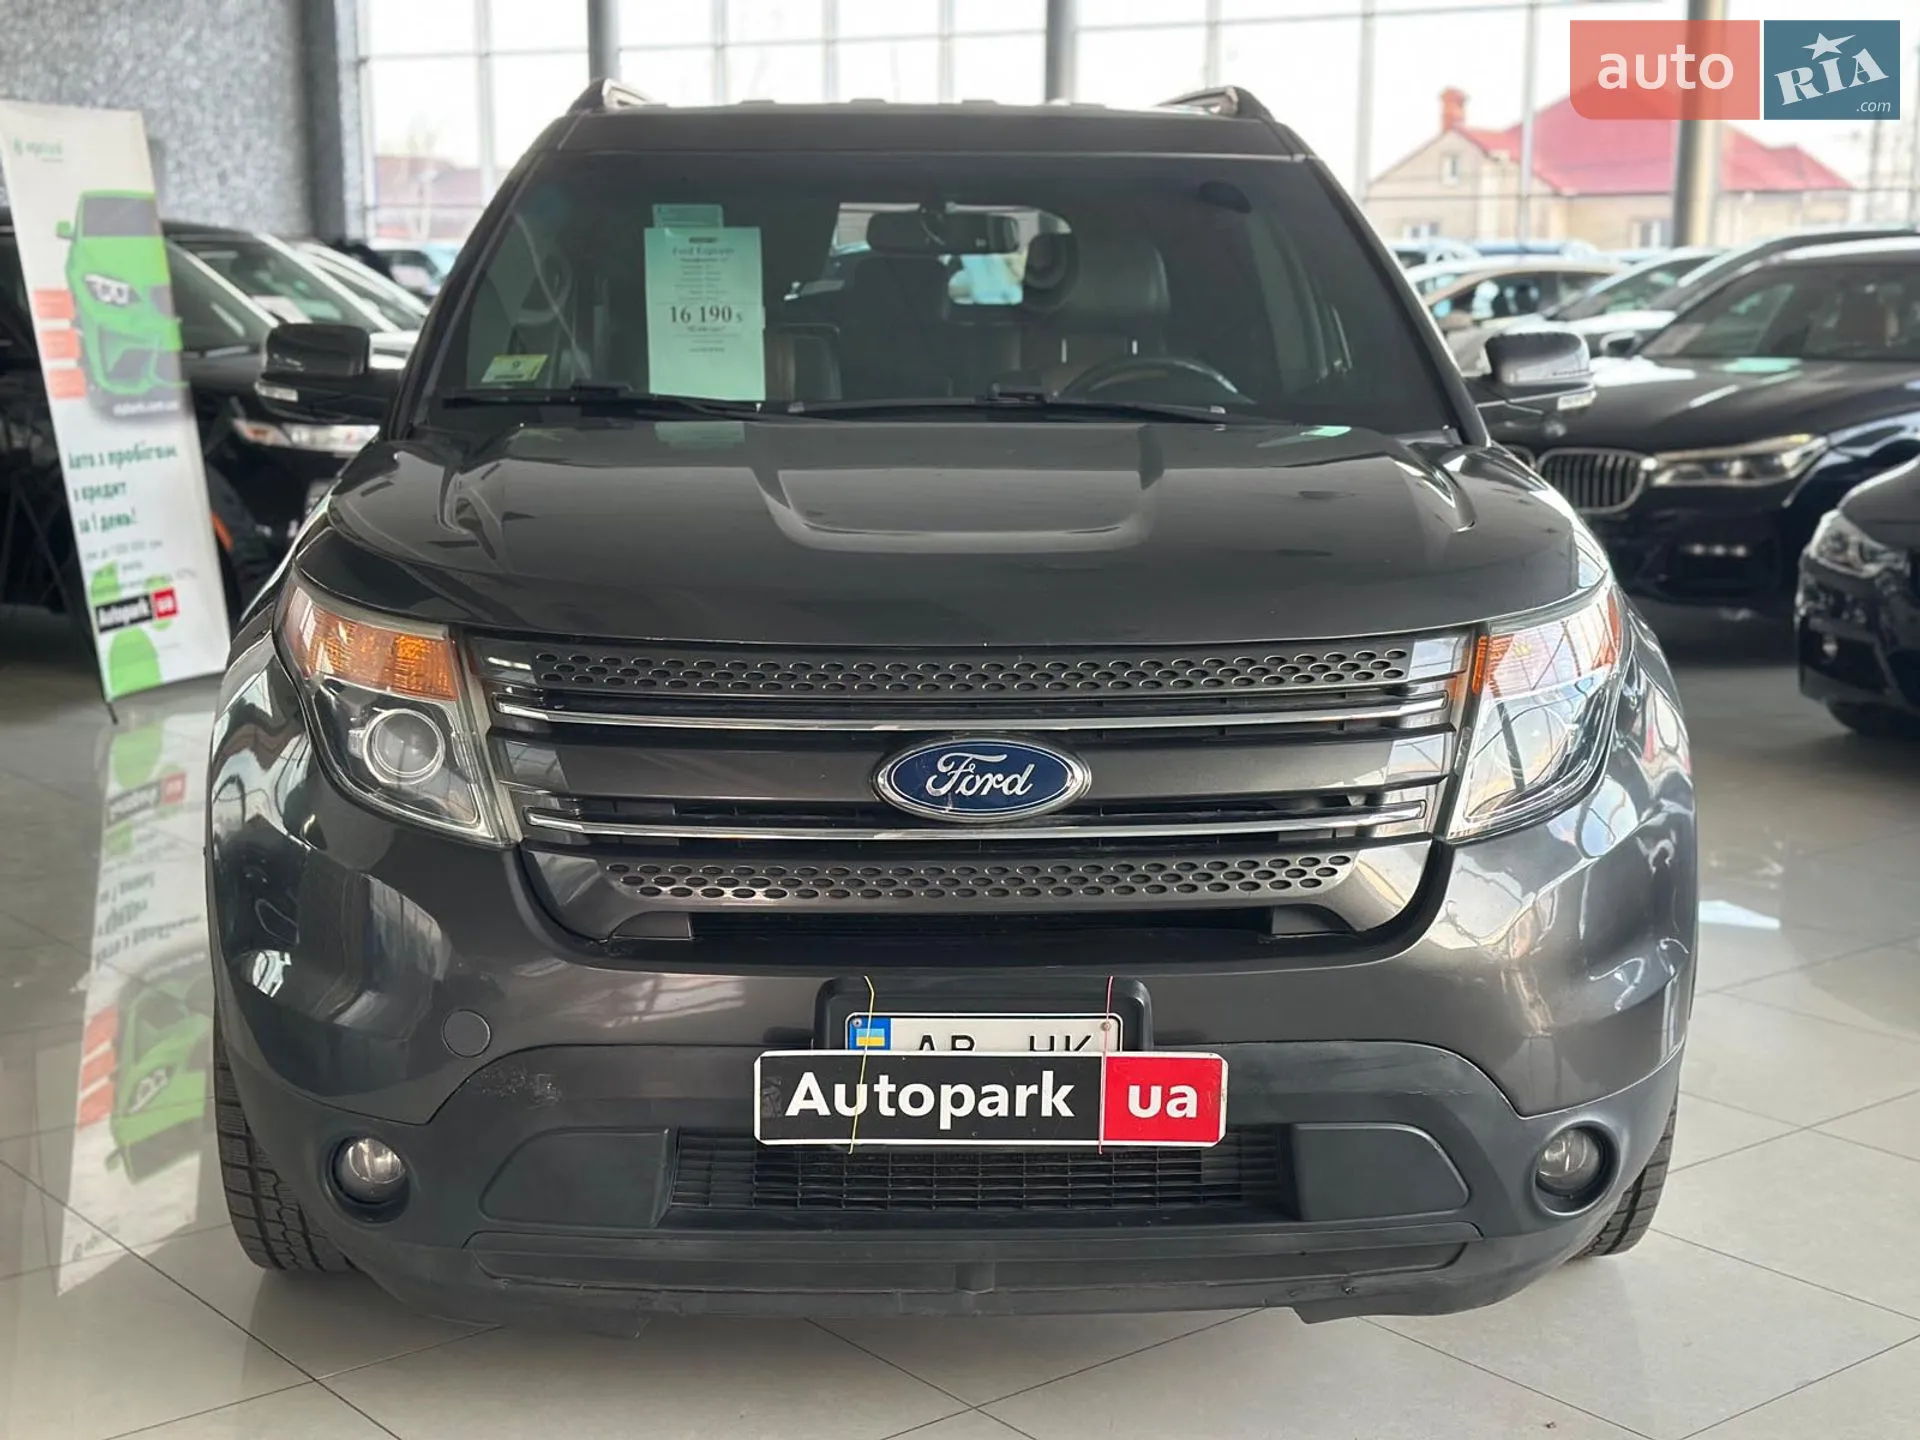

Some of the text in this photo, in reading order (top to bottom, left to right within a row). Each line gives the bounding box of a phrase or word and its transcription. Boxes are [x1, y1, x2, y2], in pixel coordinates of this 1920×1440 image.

[671, 305, 692, 323] 16
[700, 305, 732, 323] 190
[925, 752, 1035, 796] Ford
[785, 1070, 1198, 1130] Autopark ua
